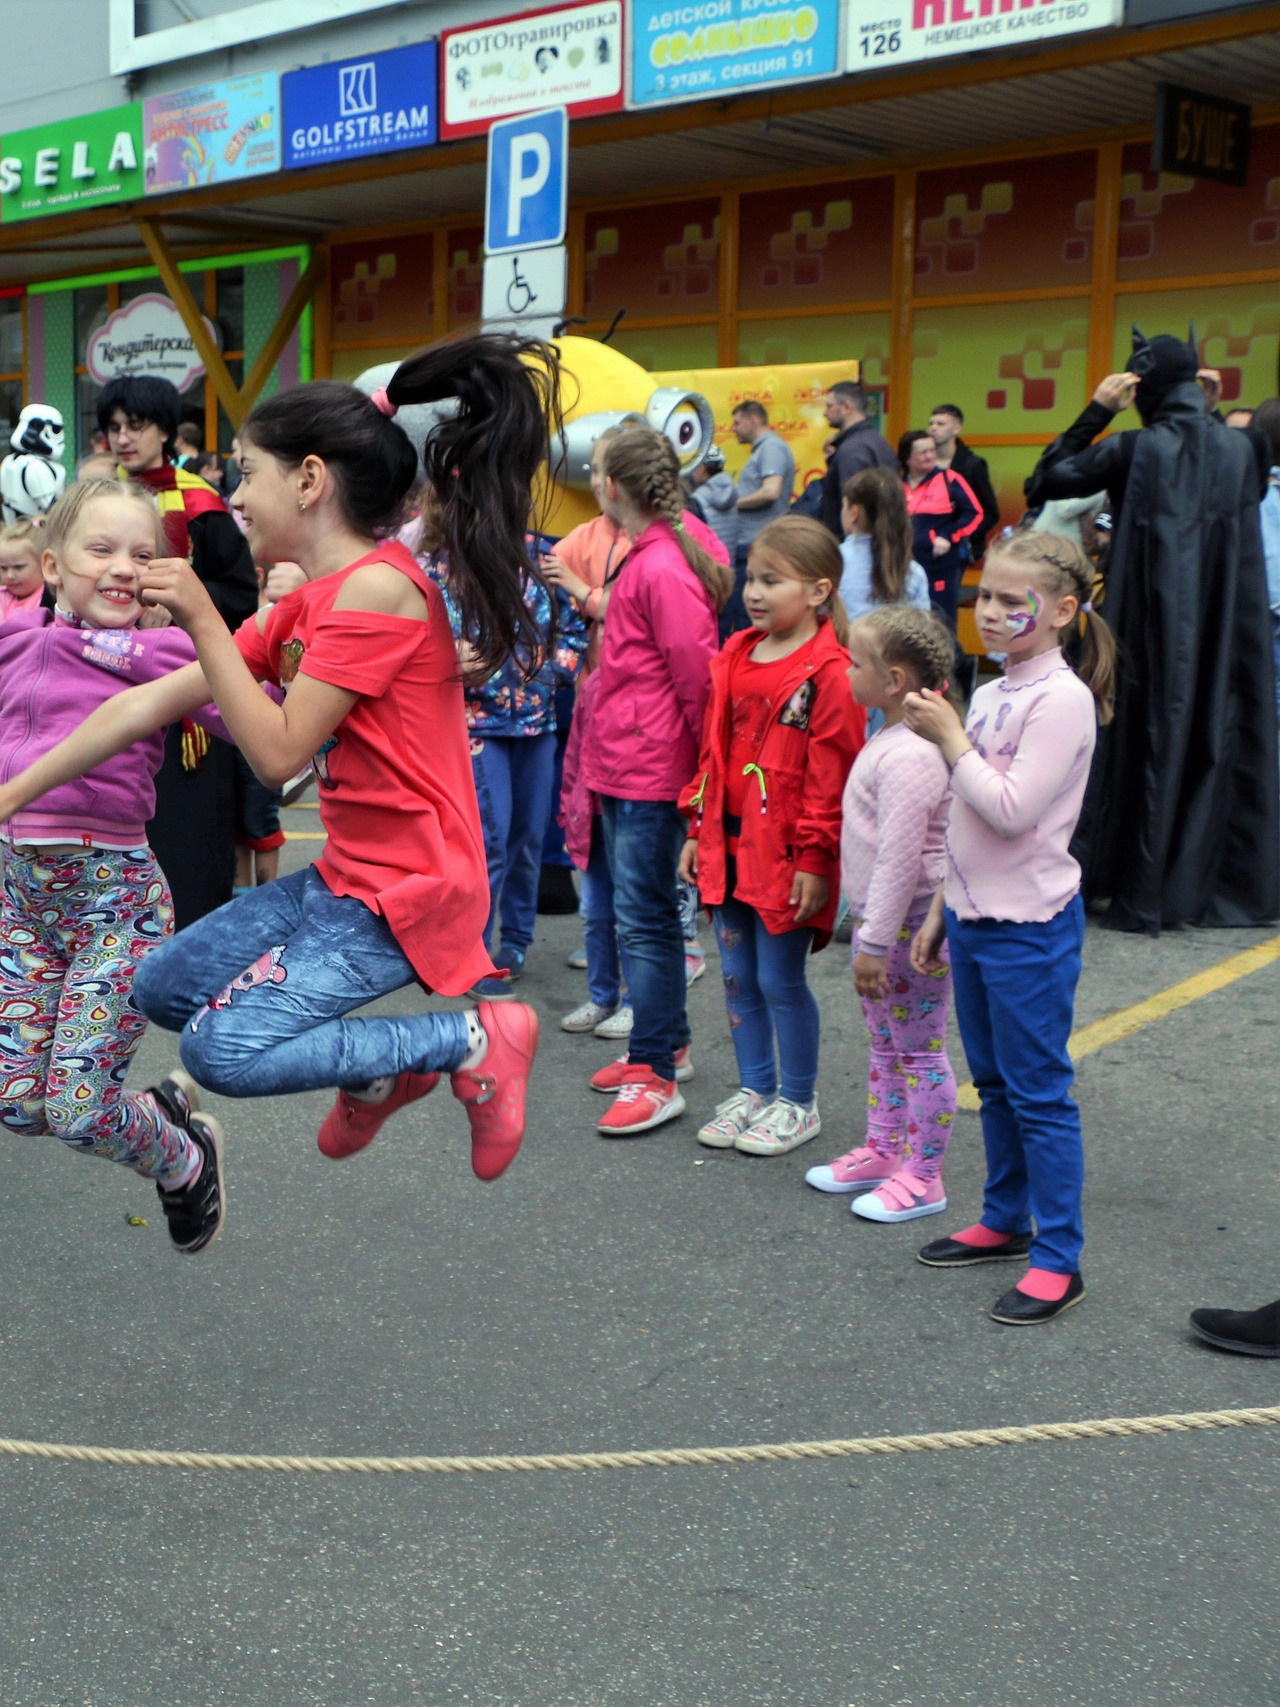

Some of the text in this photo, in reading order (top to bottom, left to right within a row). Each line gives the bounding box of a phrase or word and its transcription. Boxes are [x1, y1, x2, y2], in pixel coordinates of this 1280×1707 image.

[449, 11, 618, 59] ФОТОгравировка
[650, 6, 818, 69] СОЛНЫШКО
[860, 31, 902, 57] 126
[925, 18, 1003, 46] НЕМЕЦКОЕ
[1006, 2, 1089, 32] КАЧЕСТВО
[655, 48, 814, 91] 3 этаж, секция 91
[291, 105, 429, 150] GOLFSTREAM
[1176, 100, 1238, 171] БУШЕ
[507, 131, 551, 237] P
[98, 333, 194, 364] Кондитерска
